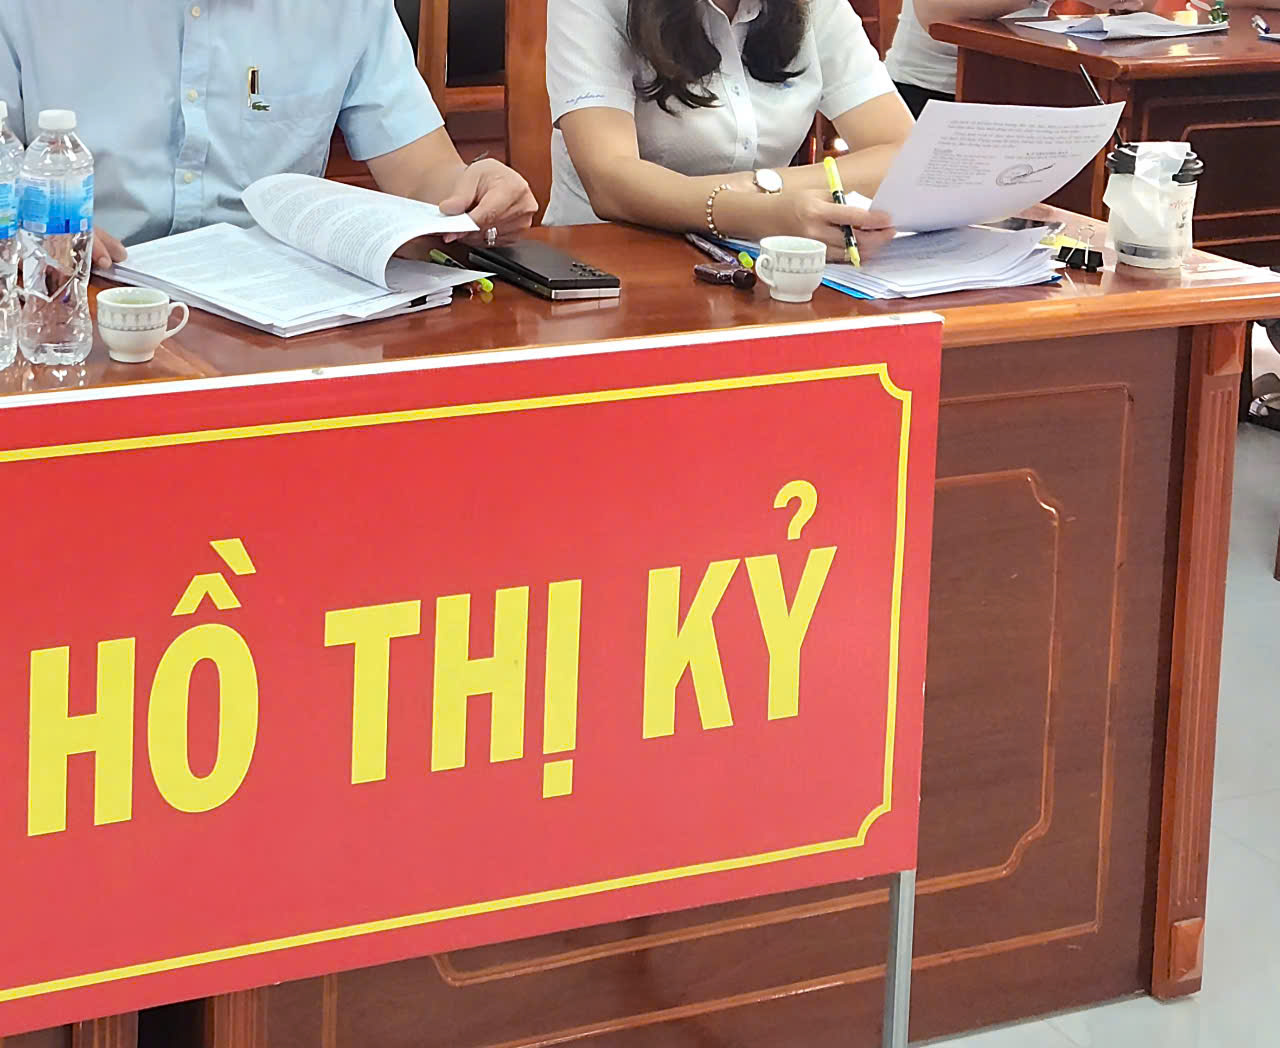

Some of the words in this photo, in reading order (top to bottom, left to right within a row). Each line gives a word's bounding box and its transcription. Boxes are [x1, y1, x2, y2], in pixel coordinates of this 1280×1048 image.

[27, 538, 259, 837] HỒ
[324, 579, 583, 799] THỊ
[643, 480, 837, 739] KỶ
